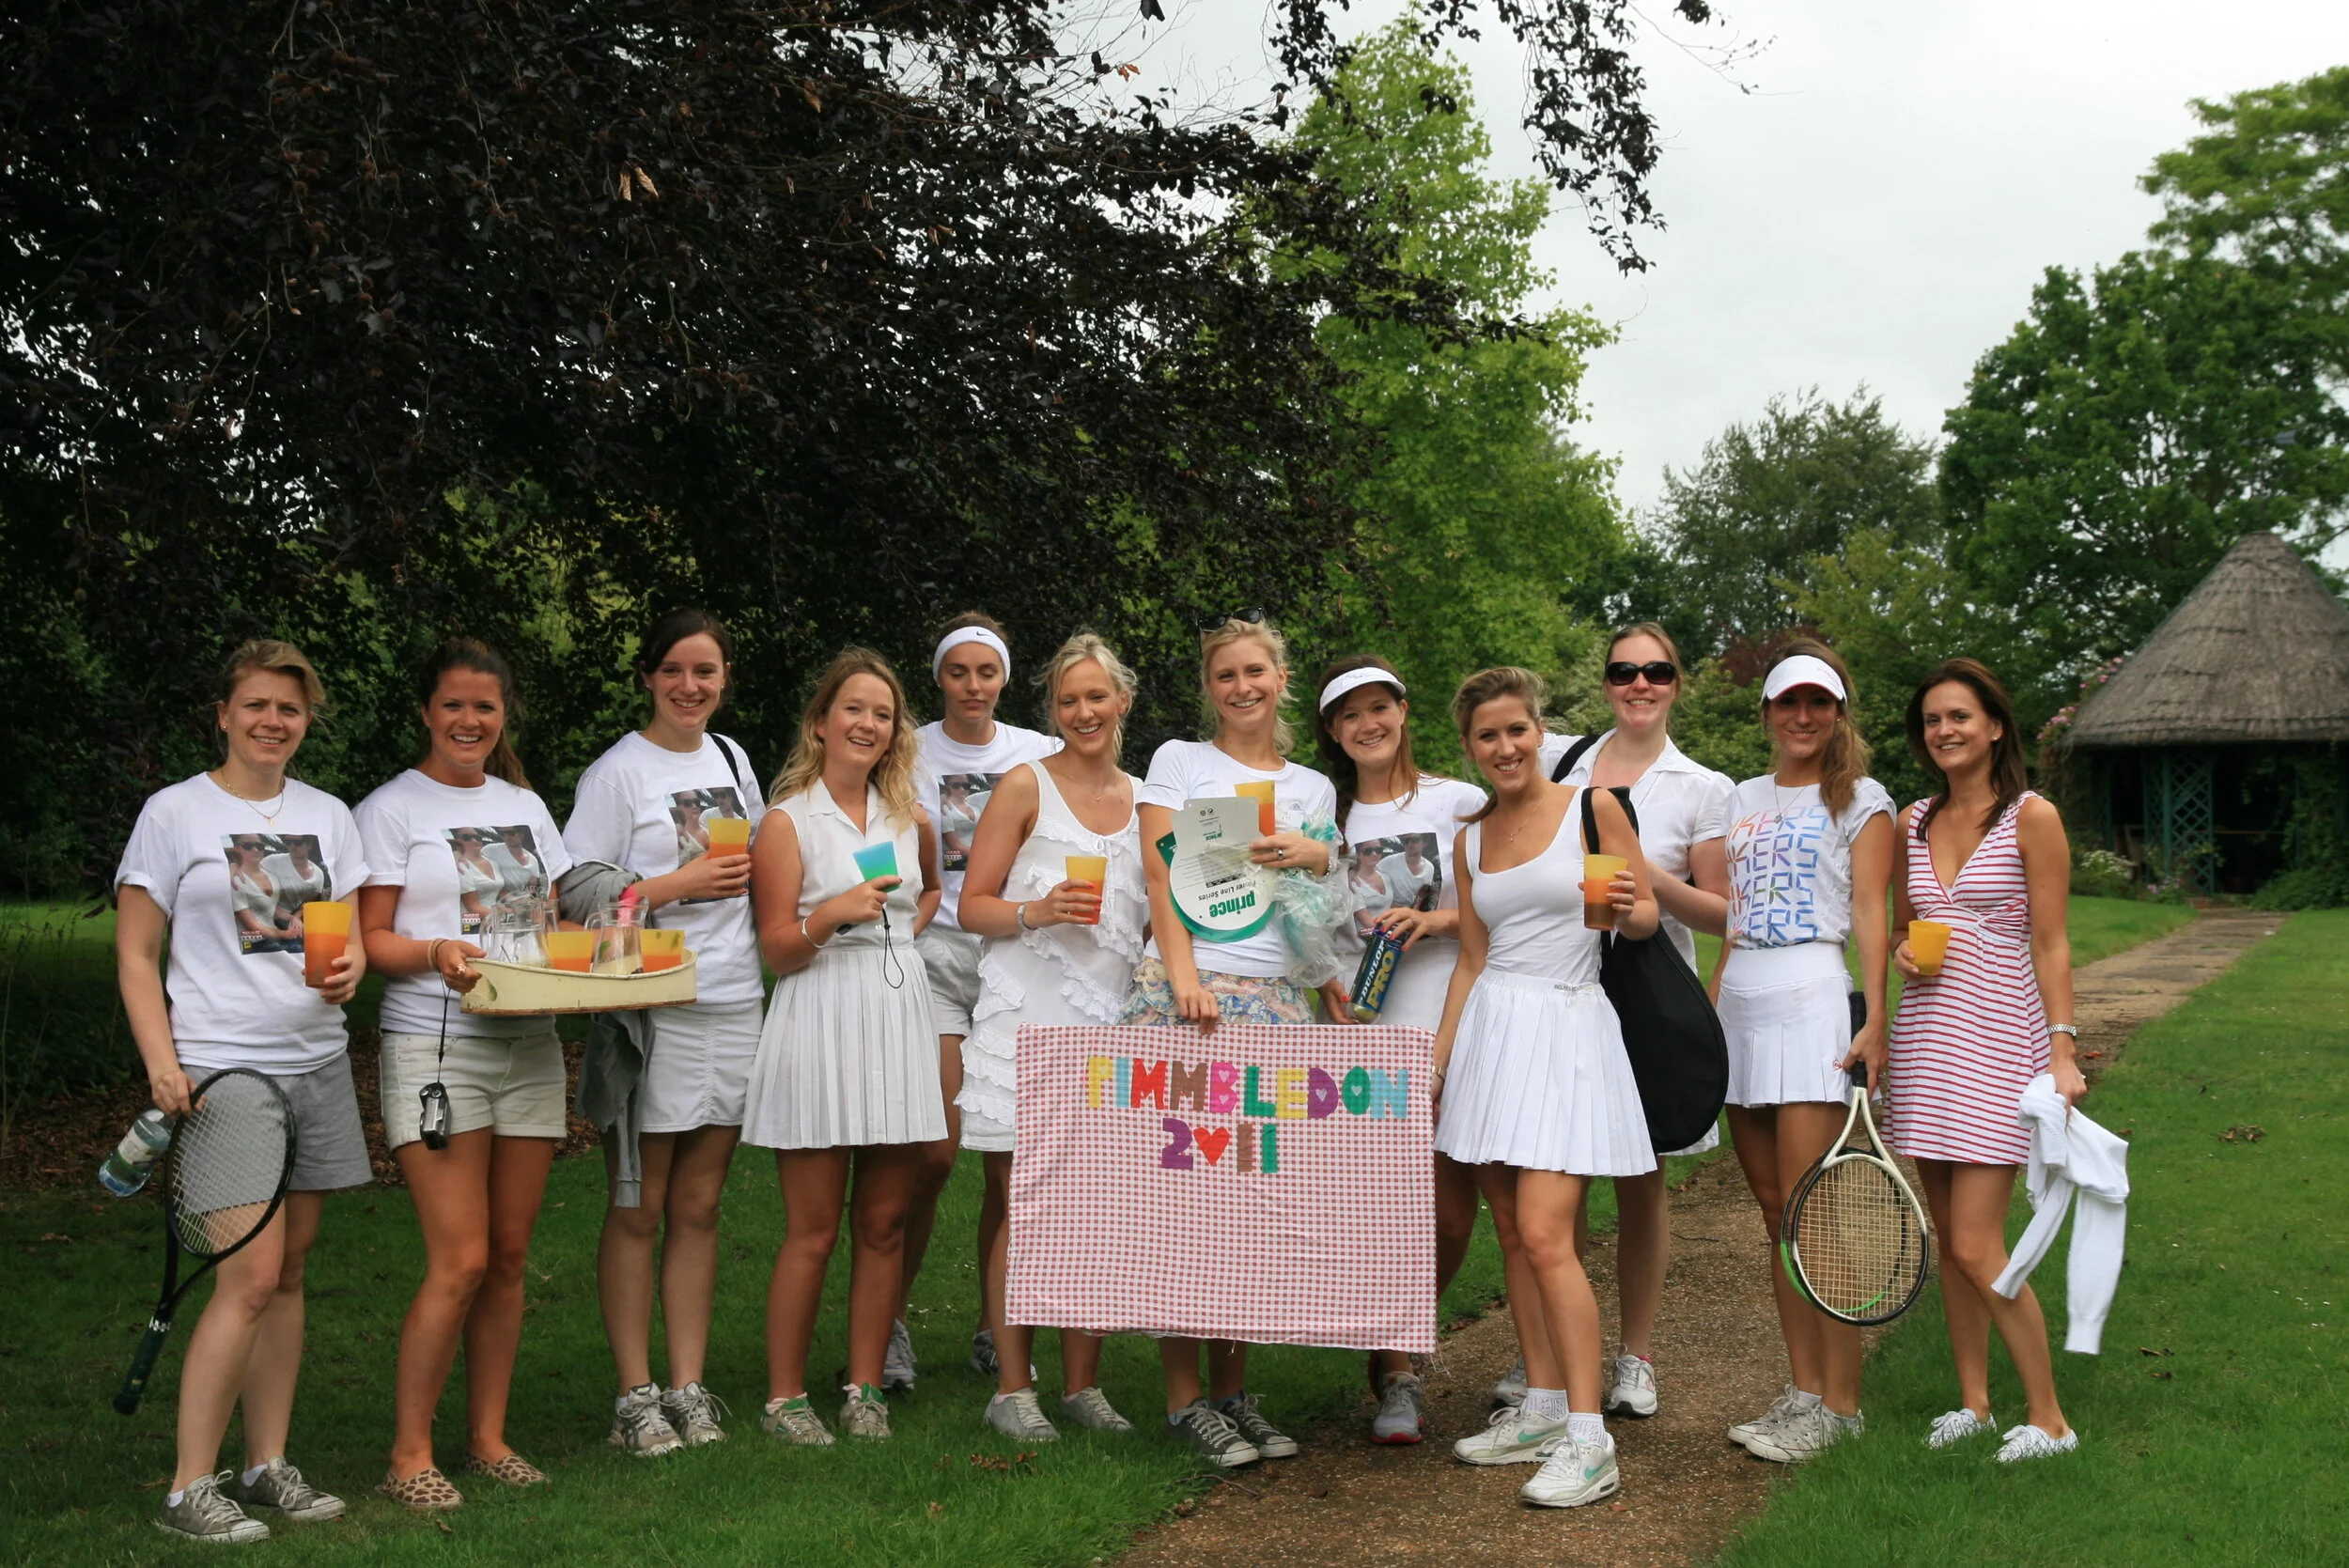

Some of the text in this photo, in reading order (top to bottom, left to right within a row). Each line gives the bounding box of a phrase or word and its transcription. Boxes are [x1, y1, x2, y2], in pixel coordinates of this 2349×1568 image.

[1198, 890, 1219, 901] Series
[1209, 891, 1255, 918] prince
[1220, 884, 1235, 895] Line
[1361, 940, 1386, 997] DUNLOP
[1366, 950, 1395, 1010] PRO
[1087, 1056, 1408, 1120] PIMMBLEDON
